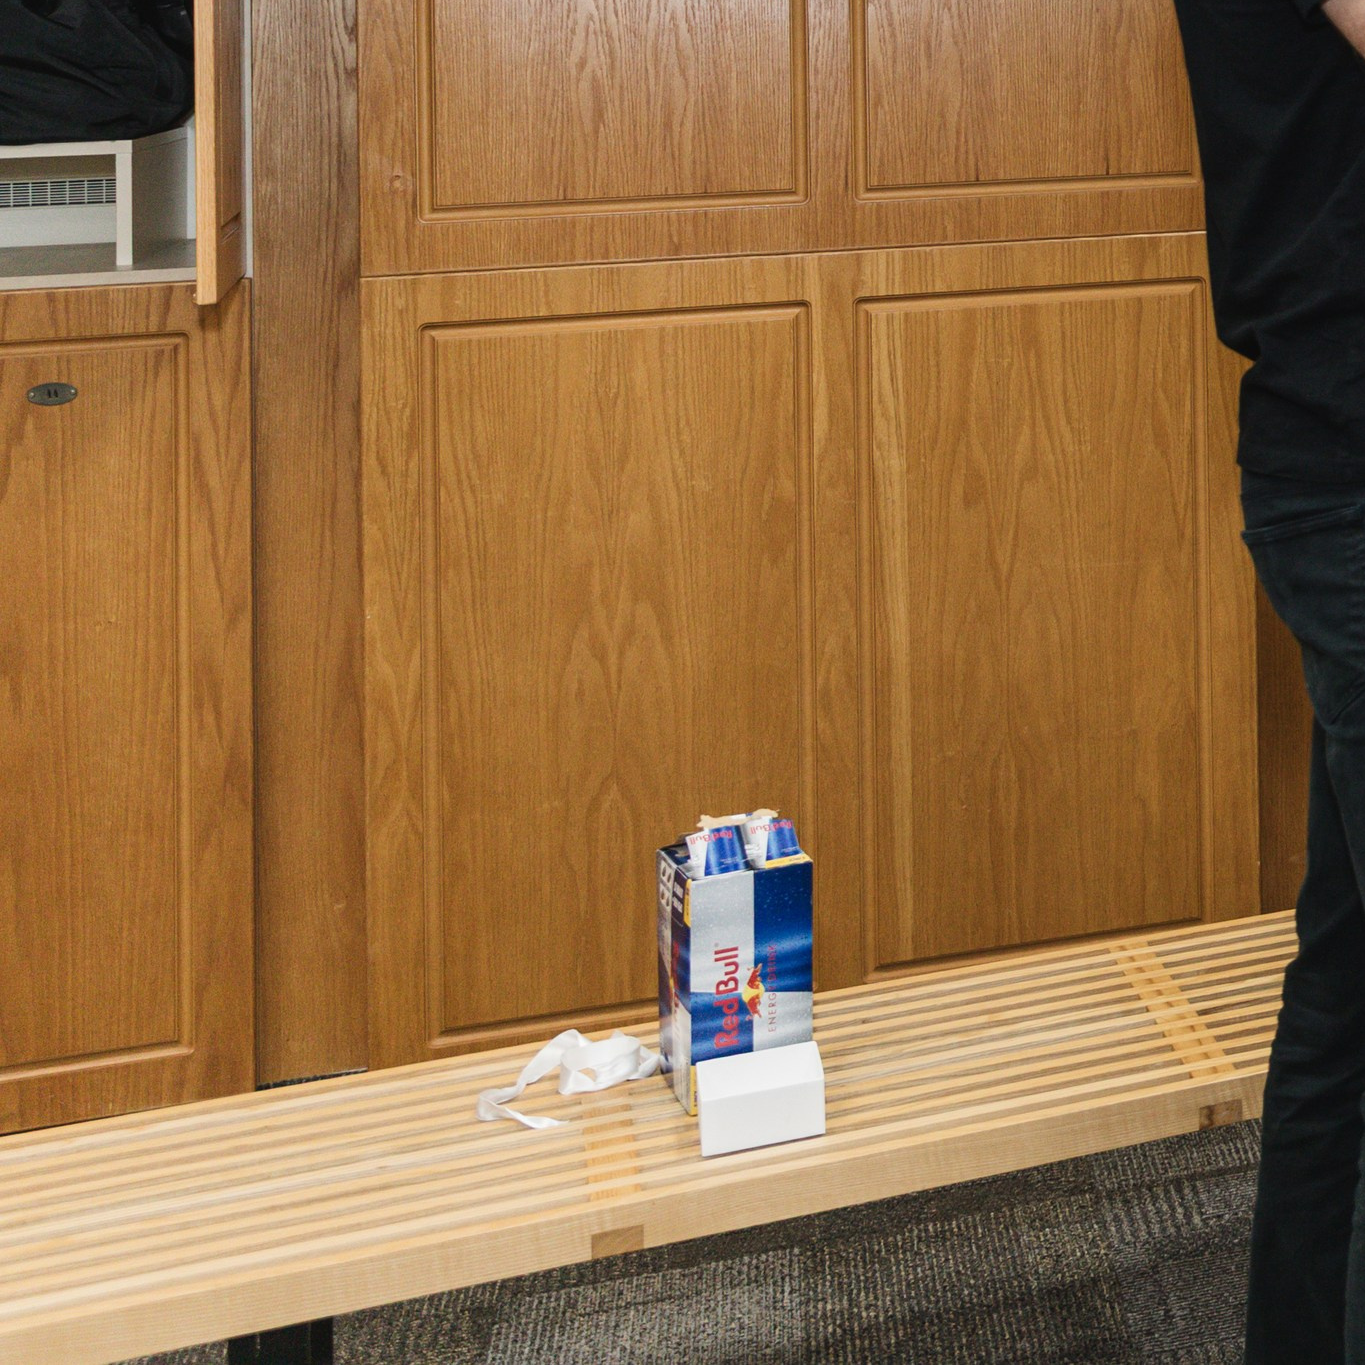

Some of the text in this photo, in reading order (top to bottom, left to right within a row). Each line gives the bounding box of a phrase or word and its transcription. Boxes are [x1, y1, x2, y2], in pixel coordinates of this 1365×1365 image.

[714, 946, 739, 1049] Red Bull
[768, 985, 777, 1033] ENERGY
